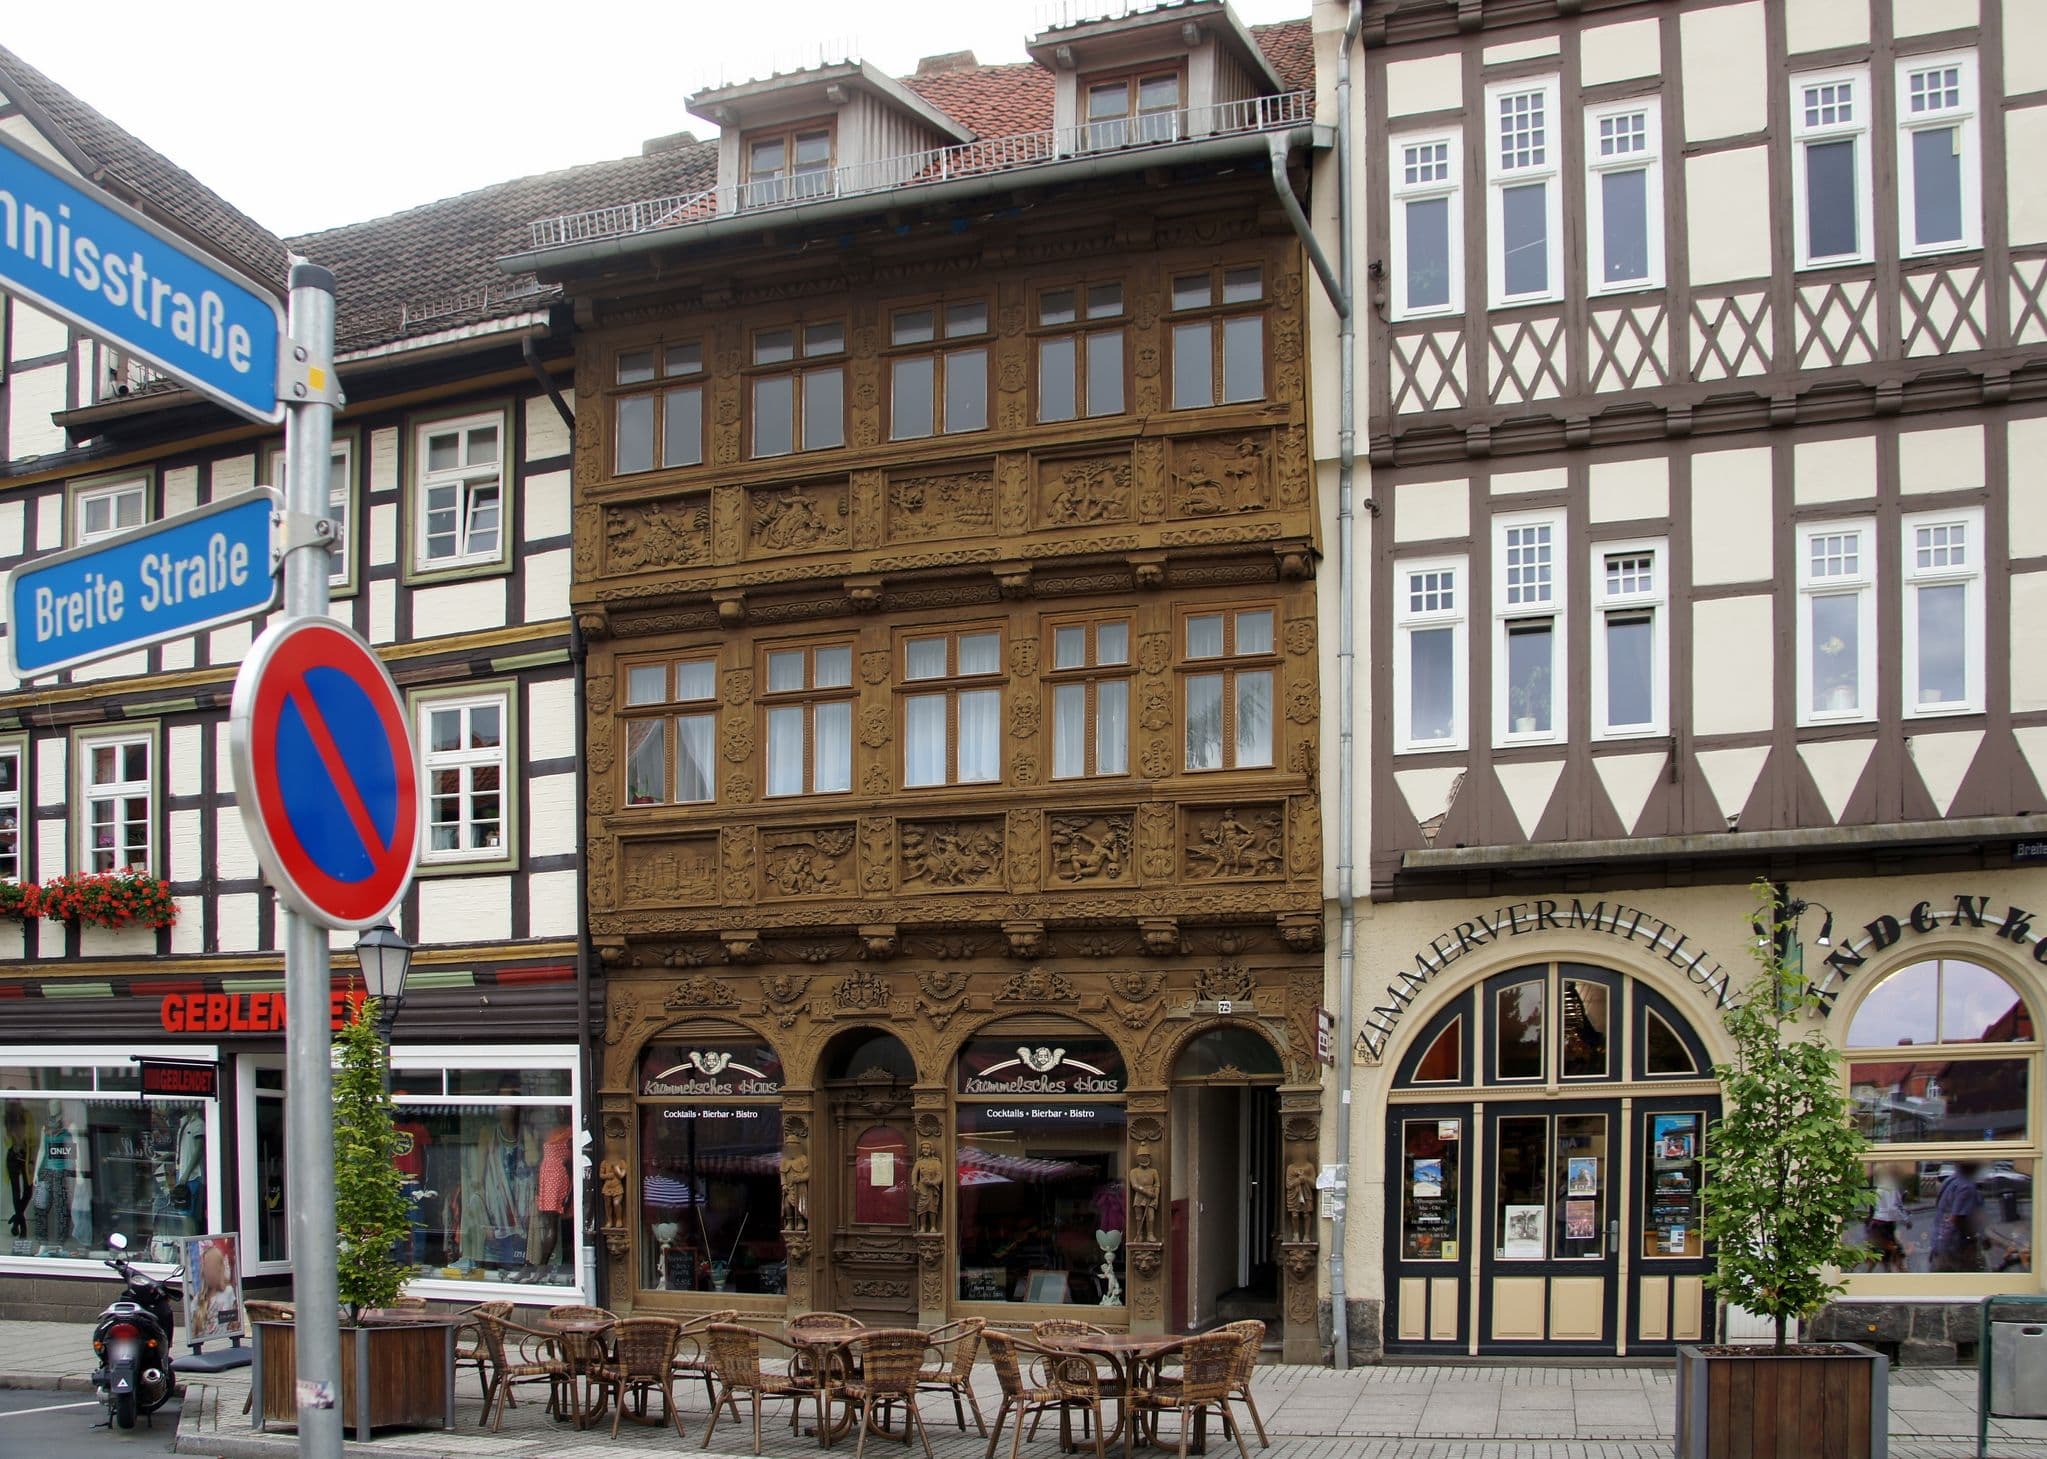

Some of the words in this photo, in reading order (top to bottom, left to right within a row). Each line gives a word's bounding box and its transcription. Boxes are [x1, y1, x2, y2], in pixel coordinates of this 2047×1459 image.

[36, 573, 124, 642] Breite
[140, 532, 249, 612] Straße
[1352, 898, 1746, 1061] ZIMMERVERMITTLUN
[1219, 1003, 1230, 1012] 72
[160, 1067, 213, 1092] GEBLENDET
[738, 1078, 778, 1094] Haus
[1073, 1075, 1118, 1093] Haus
[663, 1110, 697, 1119] Cocktails
[702, 1110, 729, 1119] Bierbar
[735, 1110, 758, 1119] Bistro
[986, 1109, 1025, 1118] Cocktails
[1031, 1109, 1062, 1118] Bierbar
[1069, 1109, 1095, 1118] Bistro
[50, 1147, 72, 1156] ONLY
